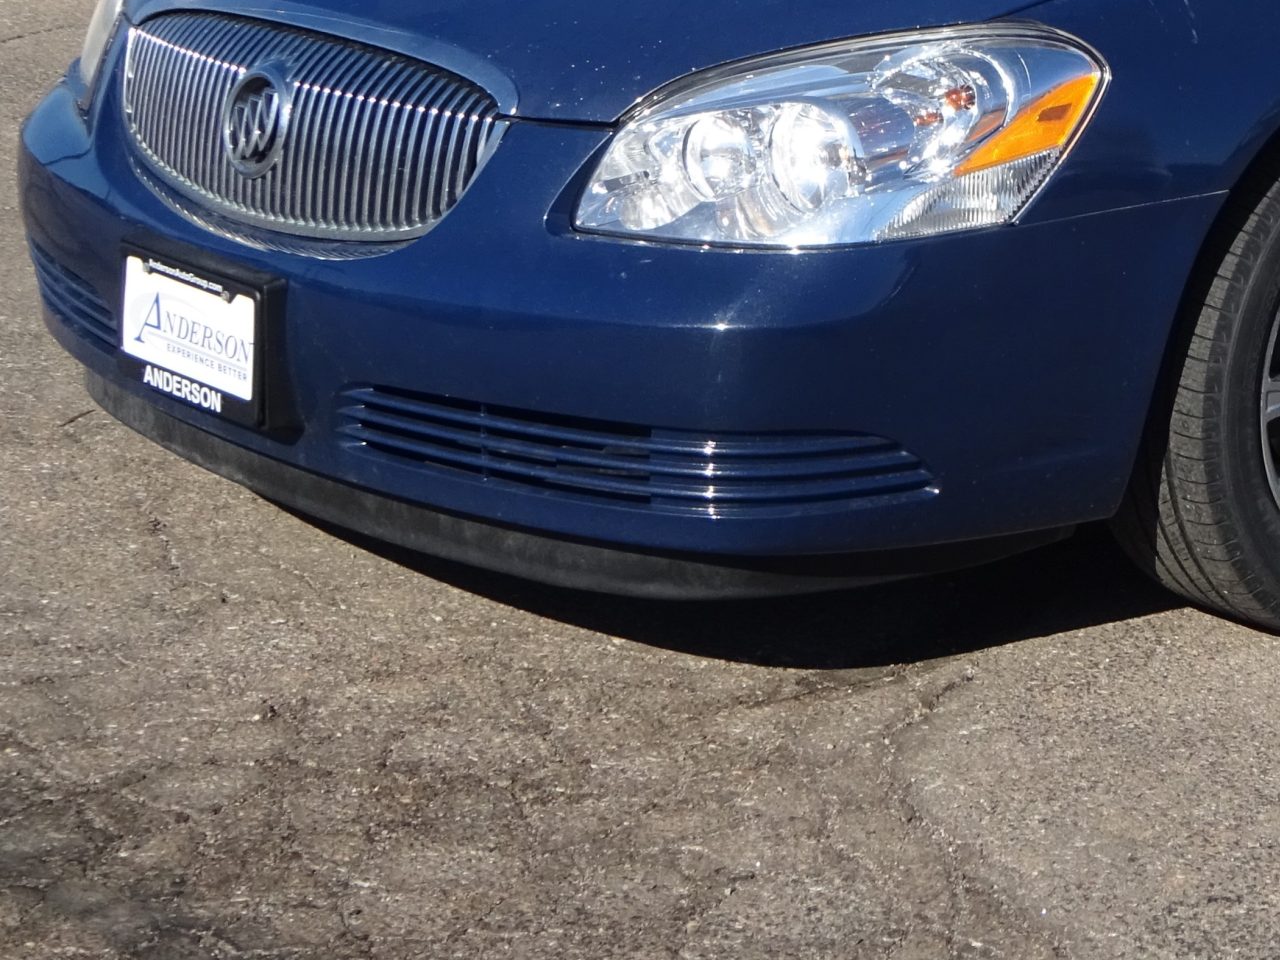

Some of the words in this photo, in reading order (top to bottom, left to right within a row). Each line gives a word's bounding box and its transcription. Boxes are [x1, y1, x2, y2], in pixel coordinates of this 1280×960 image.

[134, 291, 255, 364] ANDERSON
[167, 343, 214, 369] EXPERIENCE
[218, 364, 247, 382] BETTER
[143, 365, 222, 413] ANDERSON
